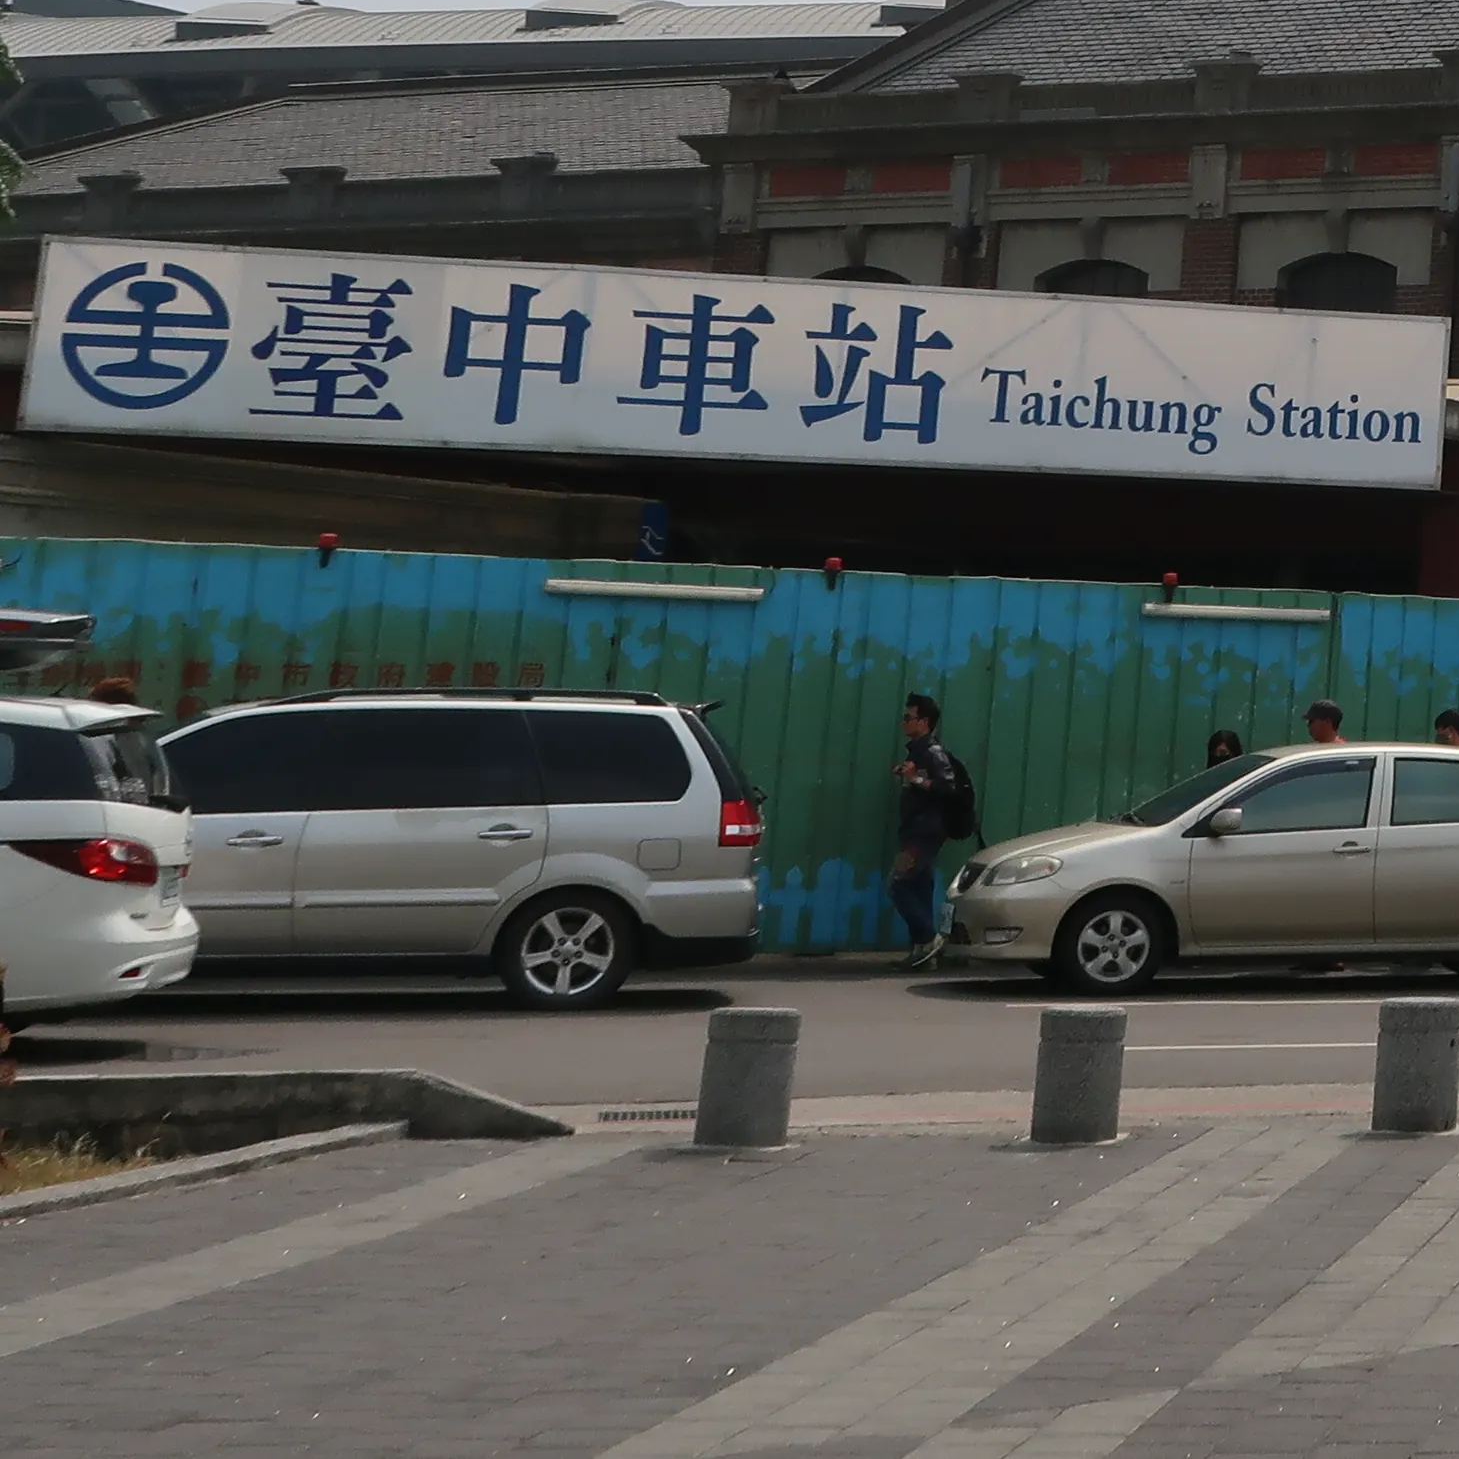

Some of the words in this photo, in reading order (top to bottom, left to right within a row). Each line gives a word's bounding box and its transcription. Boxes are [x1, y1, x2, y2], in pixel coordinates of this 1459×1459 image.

[248, 272, 953, 444] 臺中車站
[980, 367, 1222, 455] Taichung
[1245, 383, 1422, 444] Station
